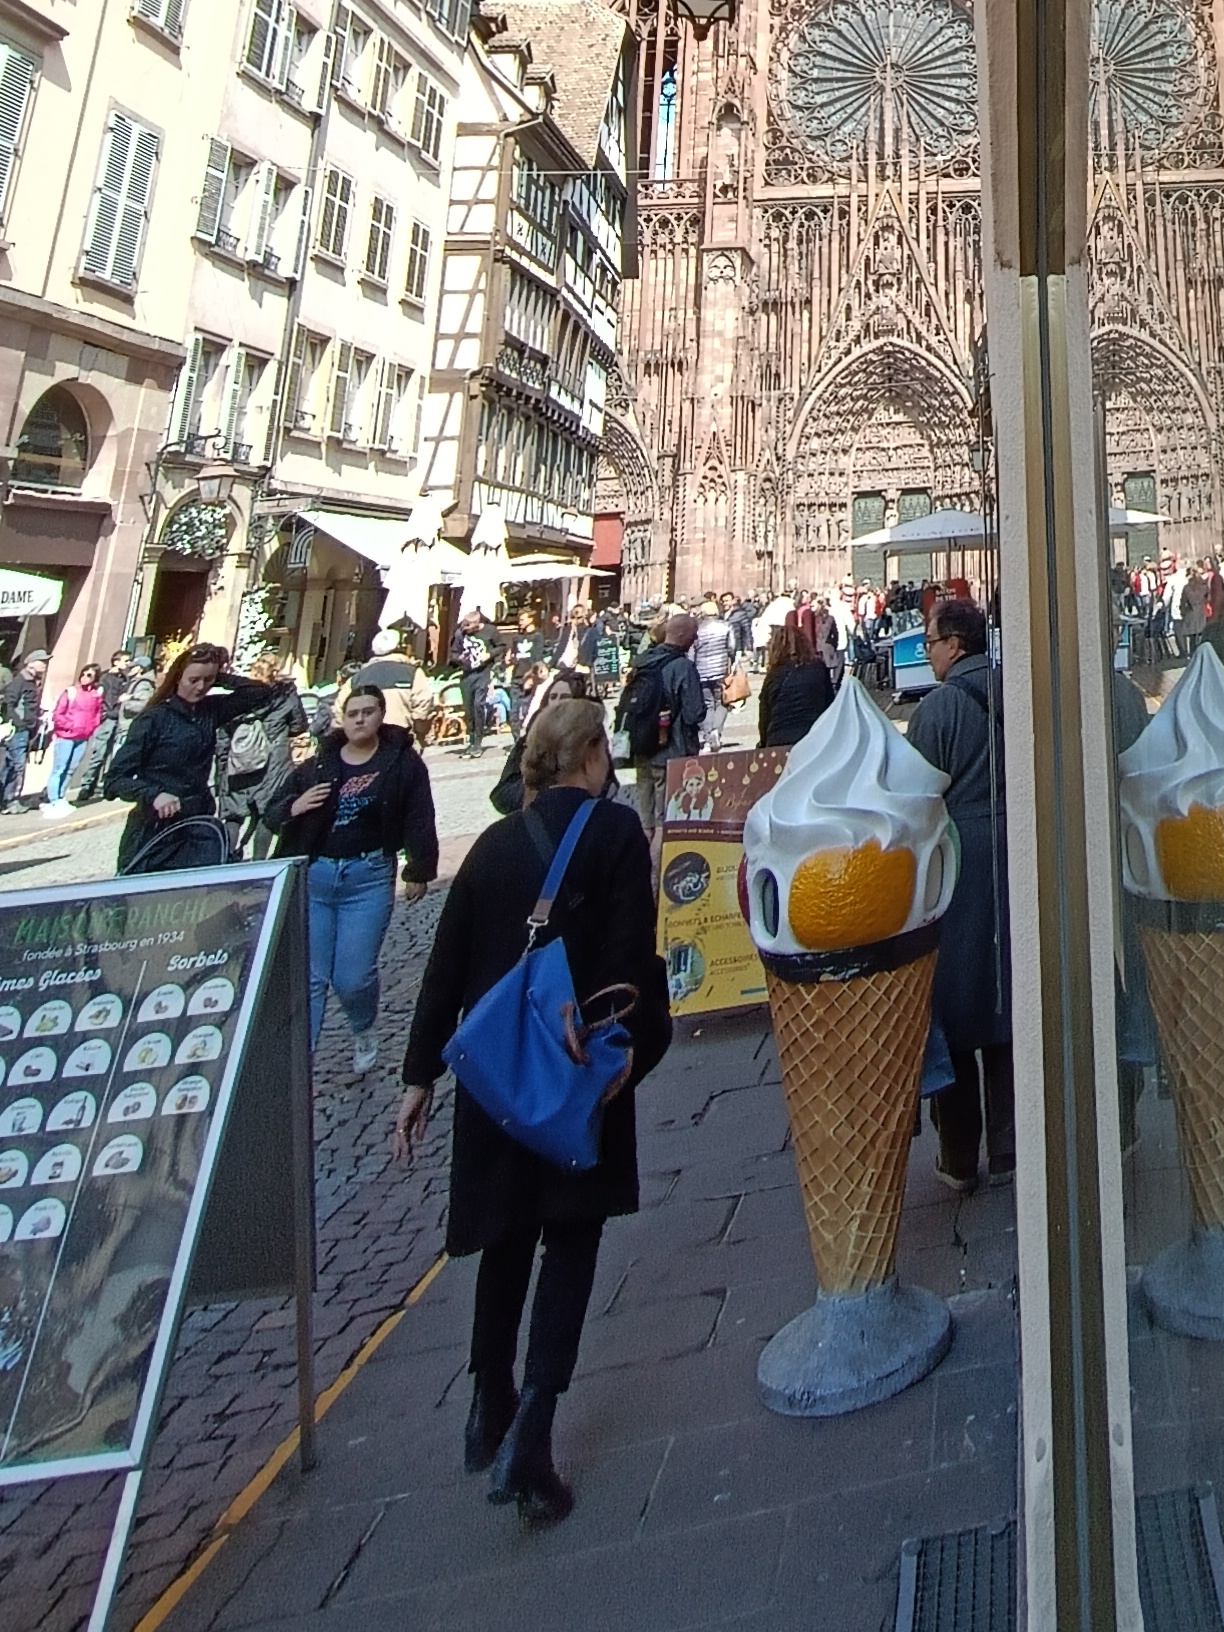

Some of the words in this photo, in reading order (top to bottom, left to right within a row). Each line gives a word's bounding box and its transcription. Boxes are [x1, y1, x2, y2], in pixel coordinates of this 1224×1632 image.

[1, 589, 35, 605] DAME
[22, 946, 63, 962] fondée
[75, 937, 137, 957] Strasbourg
[139, 936, 155, 947] en
[157, 930, 186, 946] 1934
[167, 948, 229, 972] Sorbets
[38, 968, 102, 992] Glacées
